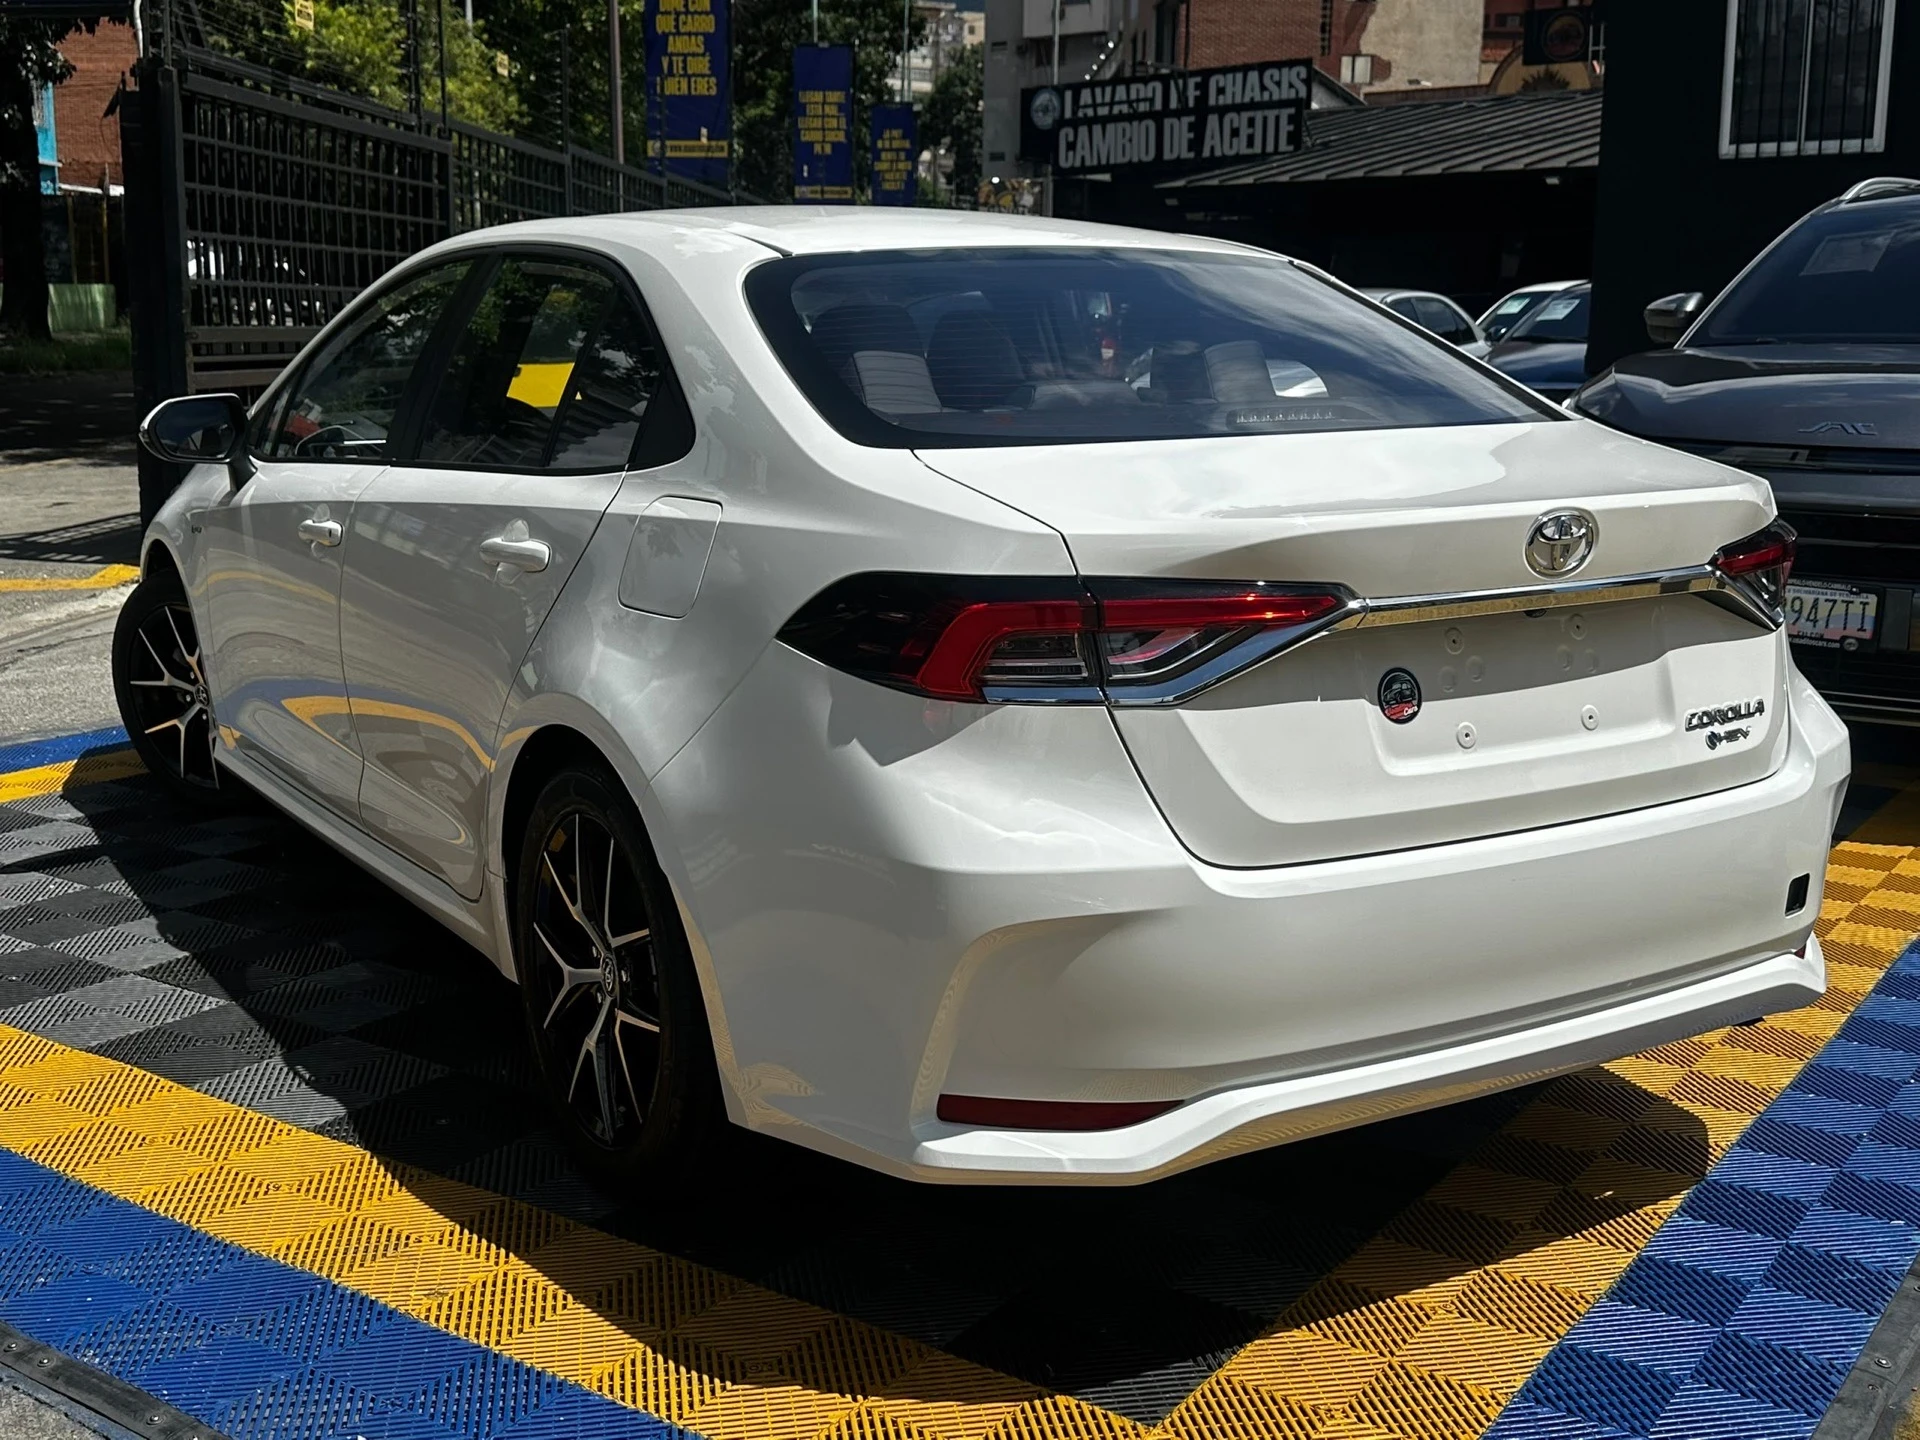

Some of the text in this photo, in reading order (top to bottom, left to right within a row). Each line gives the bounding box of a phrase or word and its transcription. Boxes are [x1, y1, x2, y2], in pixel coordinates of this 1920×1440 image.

[679, 14, 715, 33] CARRO
[667, 34, 705, 54] ANDAS
[661, 52, 711, 75] Y TE DIRÉ
[690, 76, 717, 96] ERES
[1208, 65, 1308, 108] CHASIS
[1058, 108, 1295, 169] CAMBIO DE ACEITE
[1684, 698, 1765, 732] COROLLA
